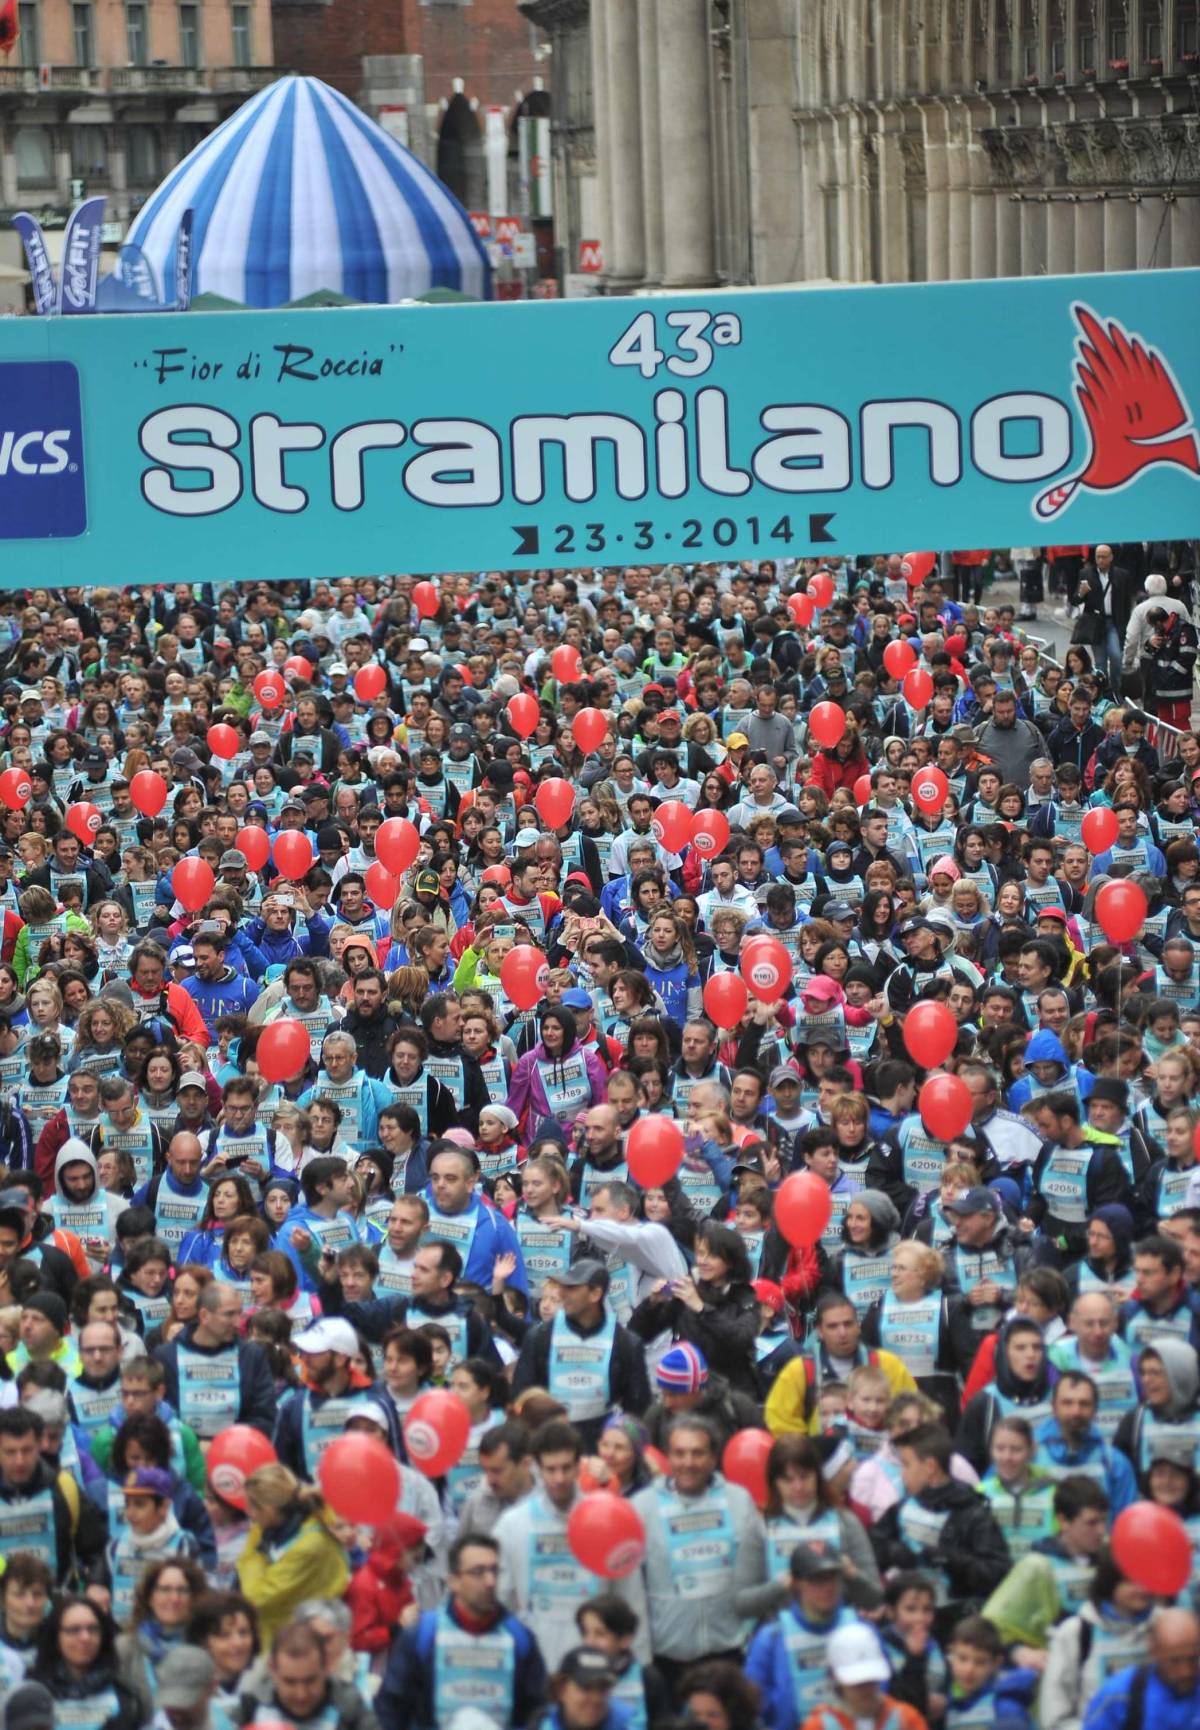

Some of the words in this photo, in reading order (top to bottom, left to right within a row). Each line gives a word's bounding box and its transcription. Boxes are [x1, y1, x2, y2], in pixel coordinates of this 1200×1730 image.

[236, 351, 260, 380] di
[138, 385, 1073, 518] Stramilano
[1048, 1182, 1079, 1193] 42056
[526, 1259, 558, 1268] 41994
